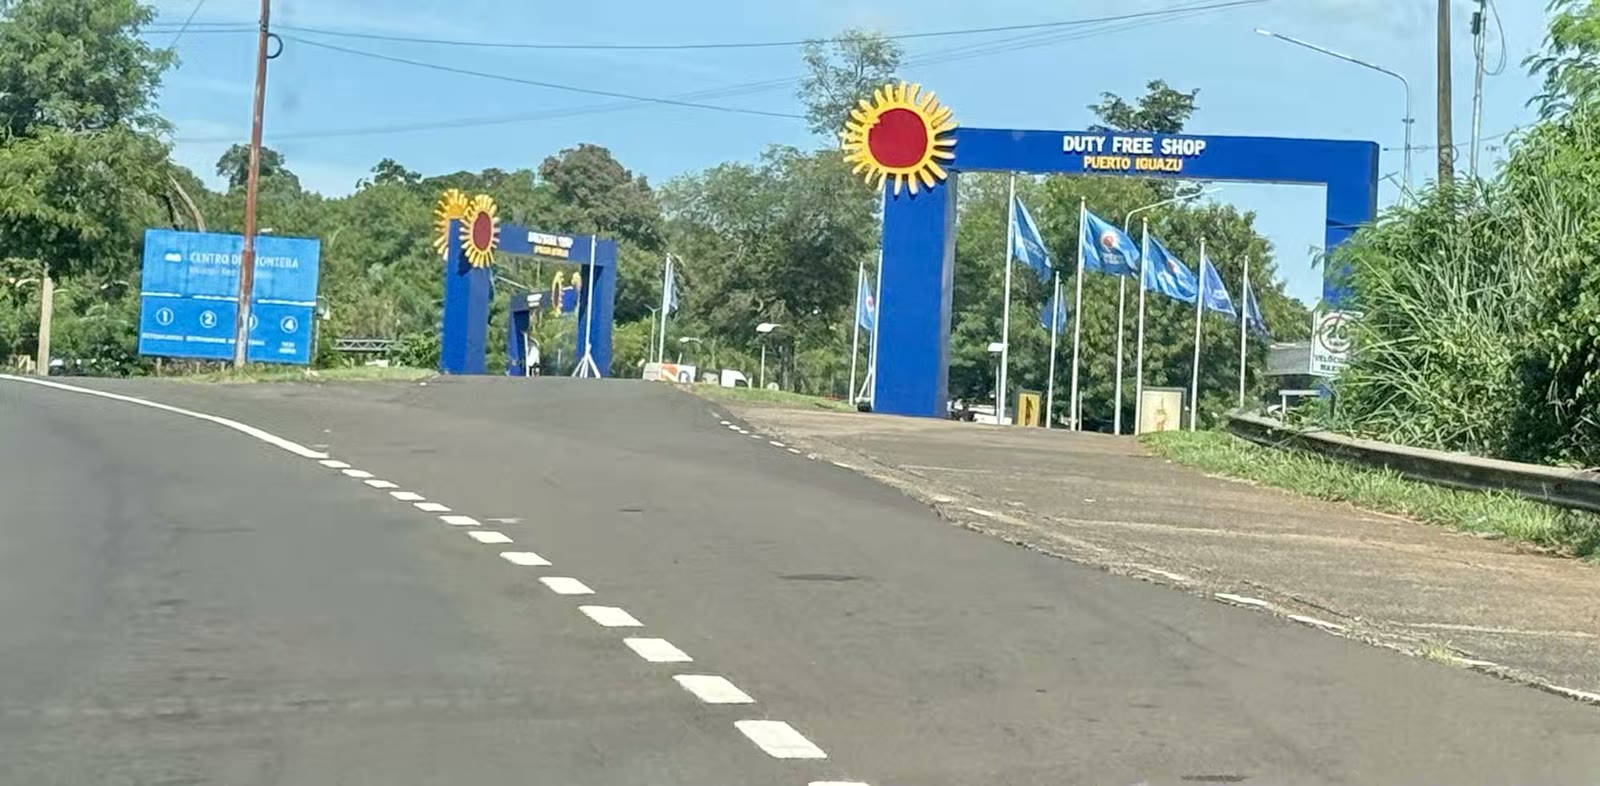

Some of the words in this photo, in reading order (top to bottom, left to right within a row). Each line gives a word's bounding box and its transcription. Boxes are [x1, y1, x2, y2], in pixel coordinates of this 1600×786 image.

[1063, 135, 1106, 153] DUTY
[1112, 136, 1153, 154] FREE
[1161, 138, 1206, 156] SHOP
[1083, 155, 1131, 169] PUERTO
[1135, 157, 1183, 172] IGUAZU
[190, 252, 229, 265] CENTRO
[204, 314, 214, 325] 2
[284, 319, 294, 330] 4
